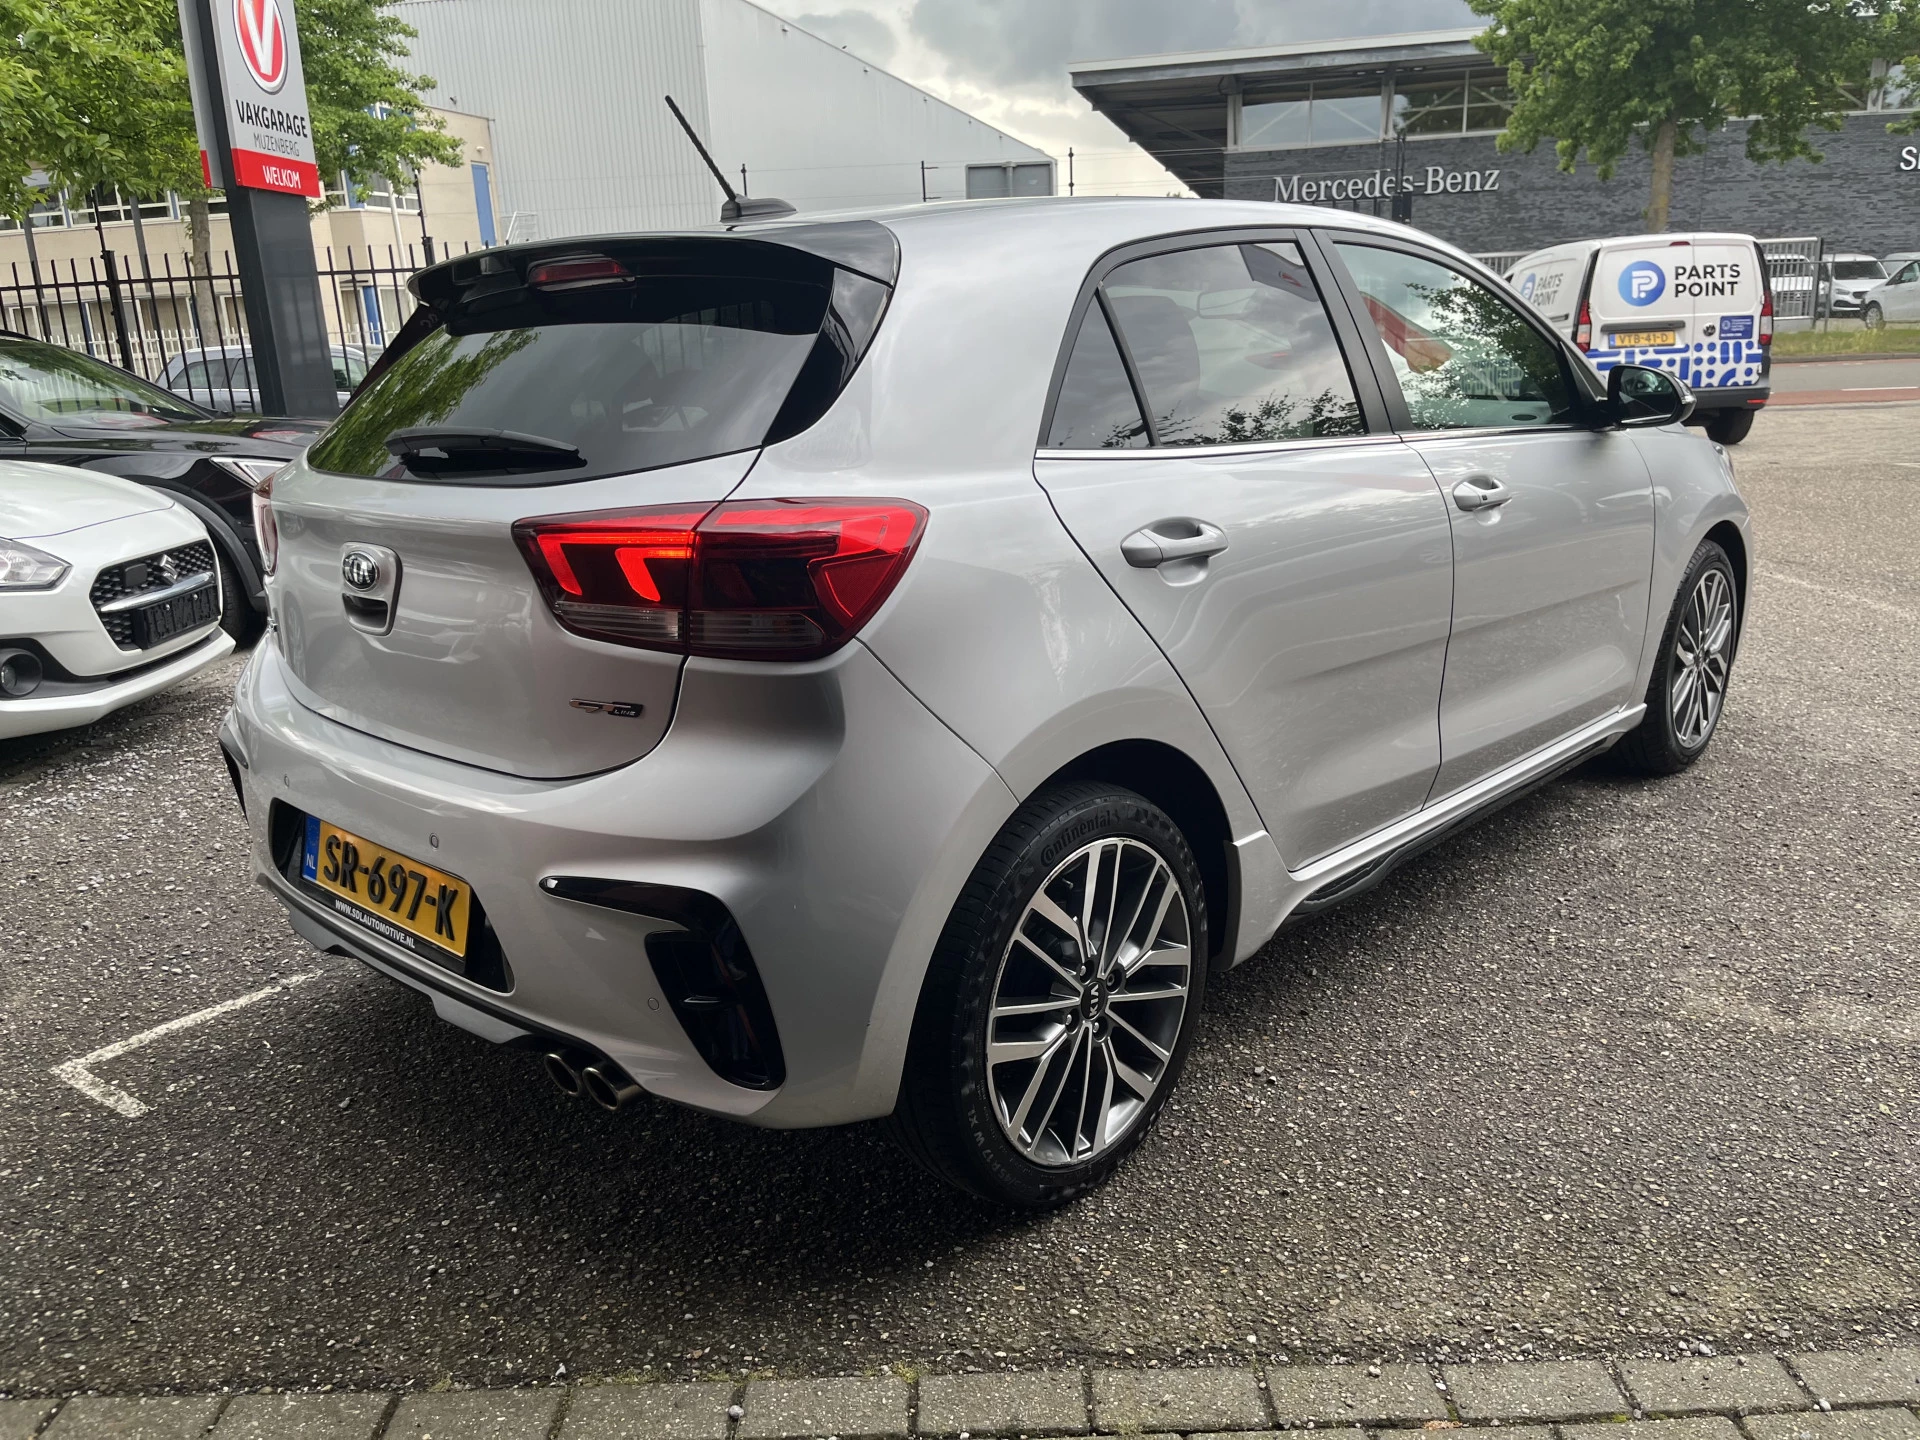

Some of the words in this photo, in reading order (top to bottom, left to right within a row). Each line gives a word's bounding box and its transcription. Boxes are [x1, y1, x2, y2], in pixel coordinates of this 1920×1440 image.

[236, 99, 308, 138] VAKGARAGE
[253, 132, 301, 157] MUZENBERG
[1899, 146, 1920, 170] S
[262, 165, 302, 189] WELKOM
[1273, 166, 1501, 203] Mercedes-Benz
[1536, 272, 1564, 291] PARTS
[1674, 264, 1741, 280] PARTS
[1533, 290, 1558, 306] POINT
[1674, 281, 1738, 298] POINT
[1618, 333, 1669, 344] VTB-41-D
[1041, 809, 1111, 868] Continental
[306, 853, 316, 870] NL
[323, 834, 459, 942] SR-697-K
[335, 899, 416, 949] WWW.SDLAUTOMOTIVE.NL
[1089, 984, 1099, 1018] KIA
